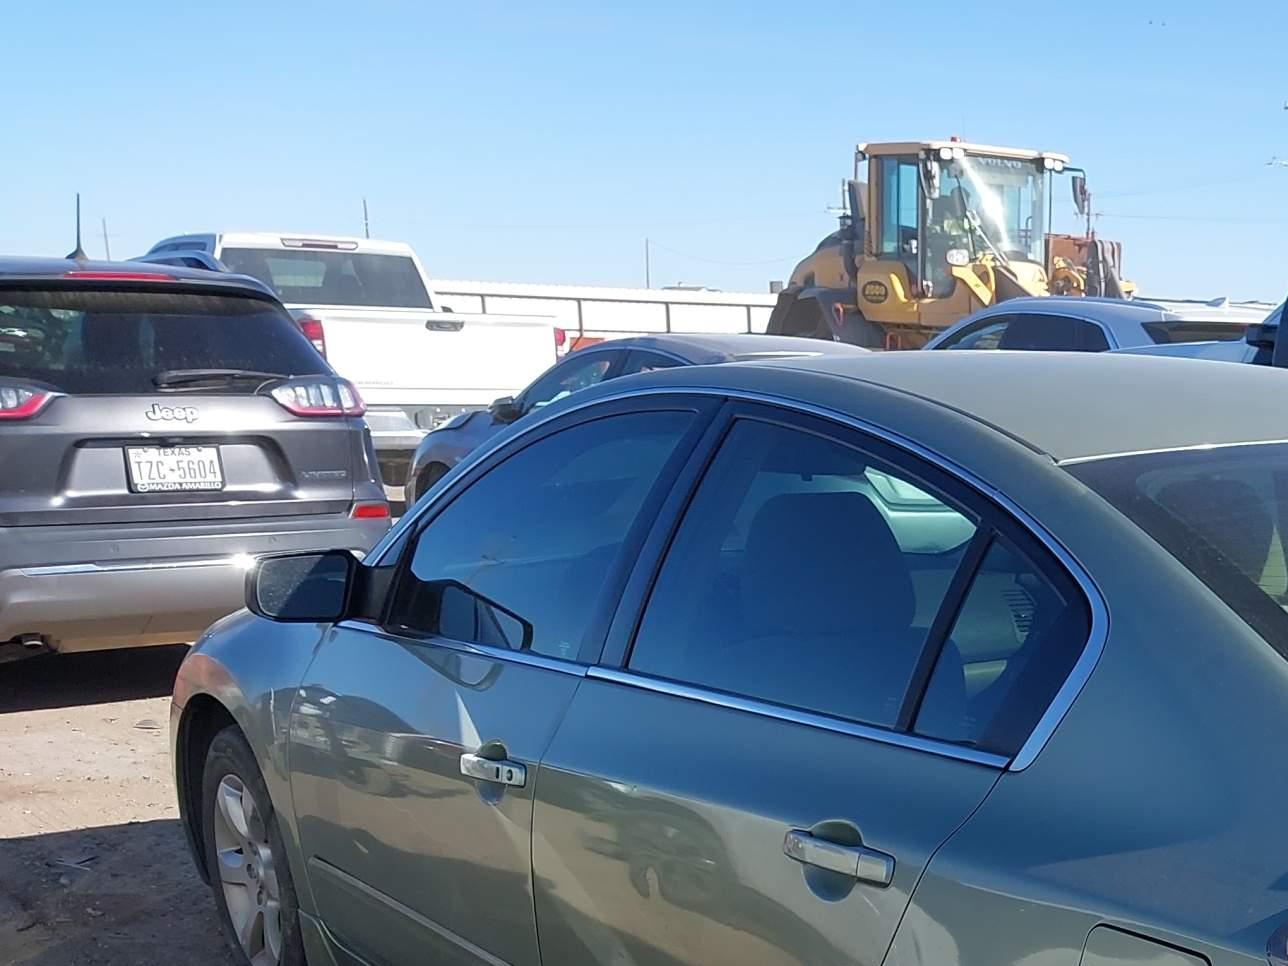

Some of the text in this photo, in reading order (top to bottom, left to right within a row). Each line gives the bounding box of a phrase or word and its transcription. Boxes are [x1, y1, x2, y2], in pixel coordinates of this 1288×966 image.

[979, 157, 1022, 169] VOLVO
[145, 403, 199, 424] Jeep
[158, 447, 191, 456] TEXAS
